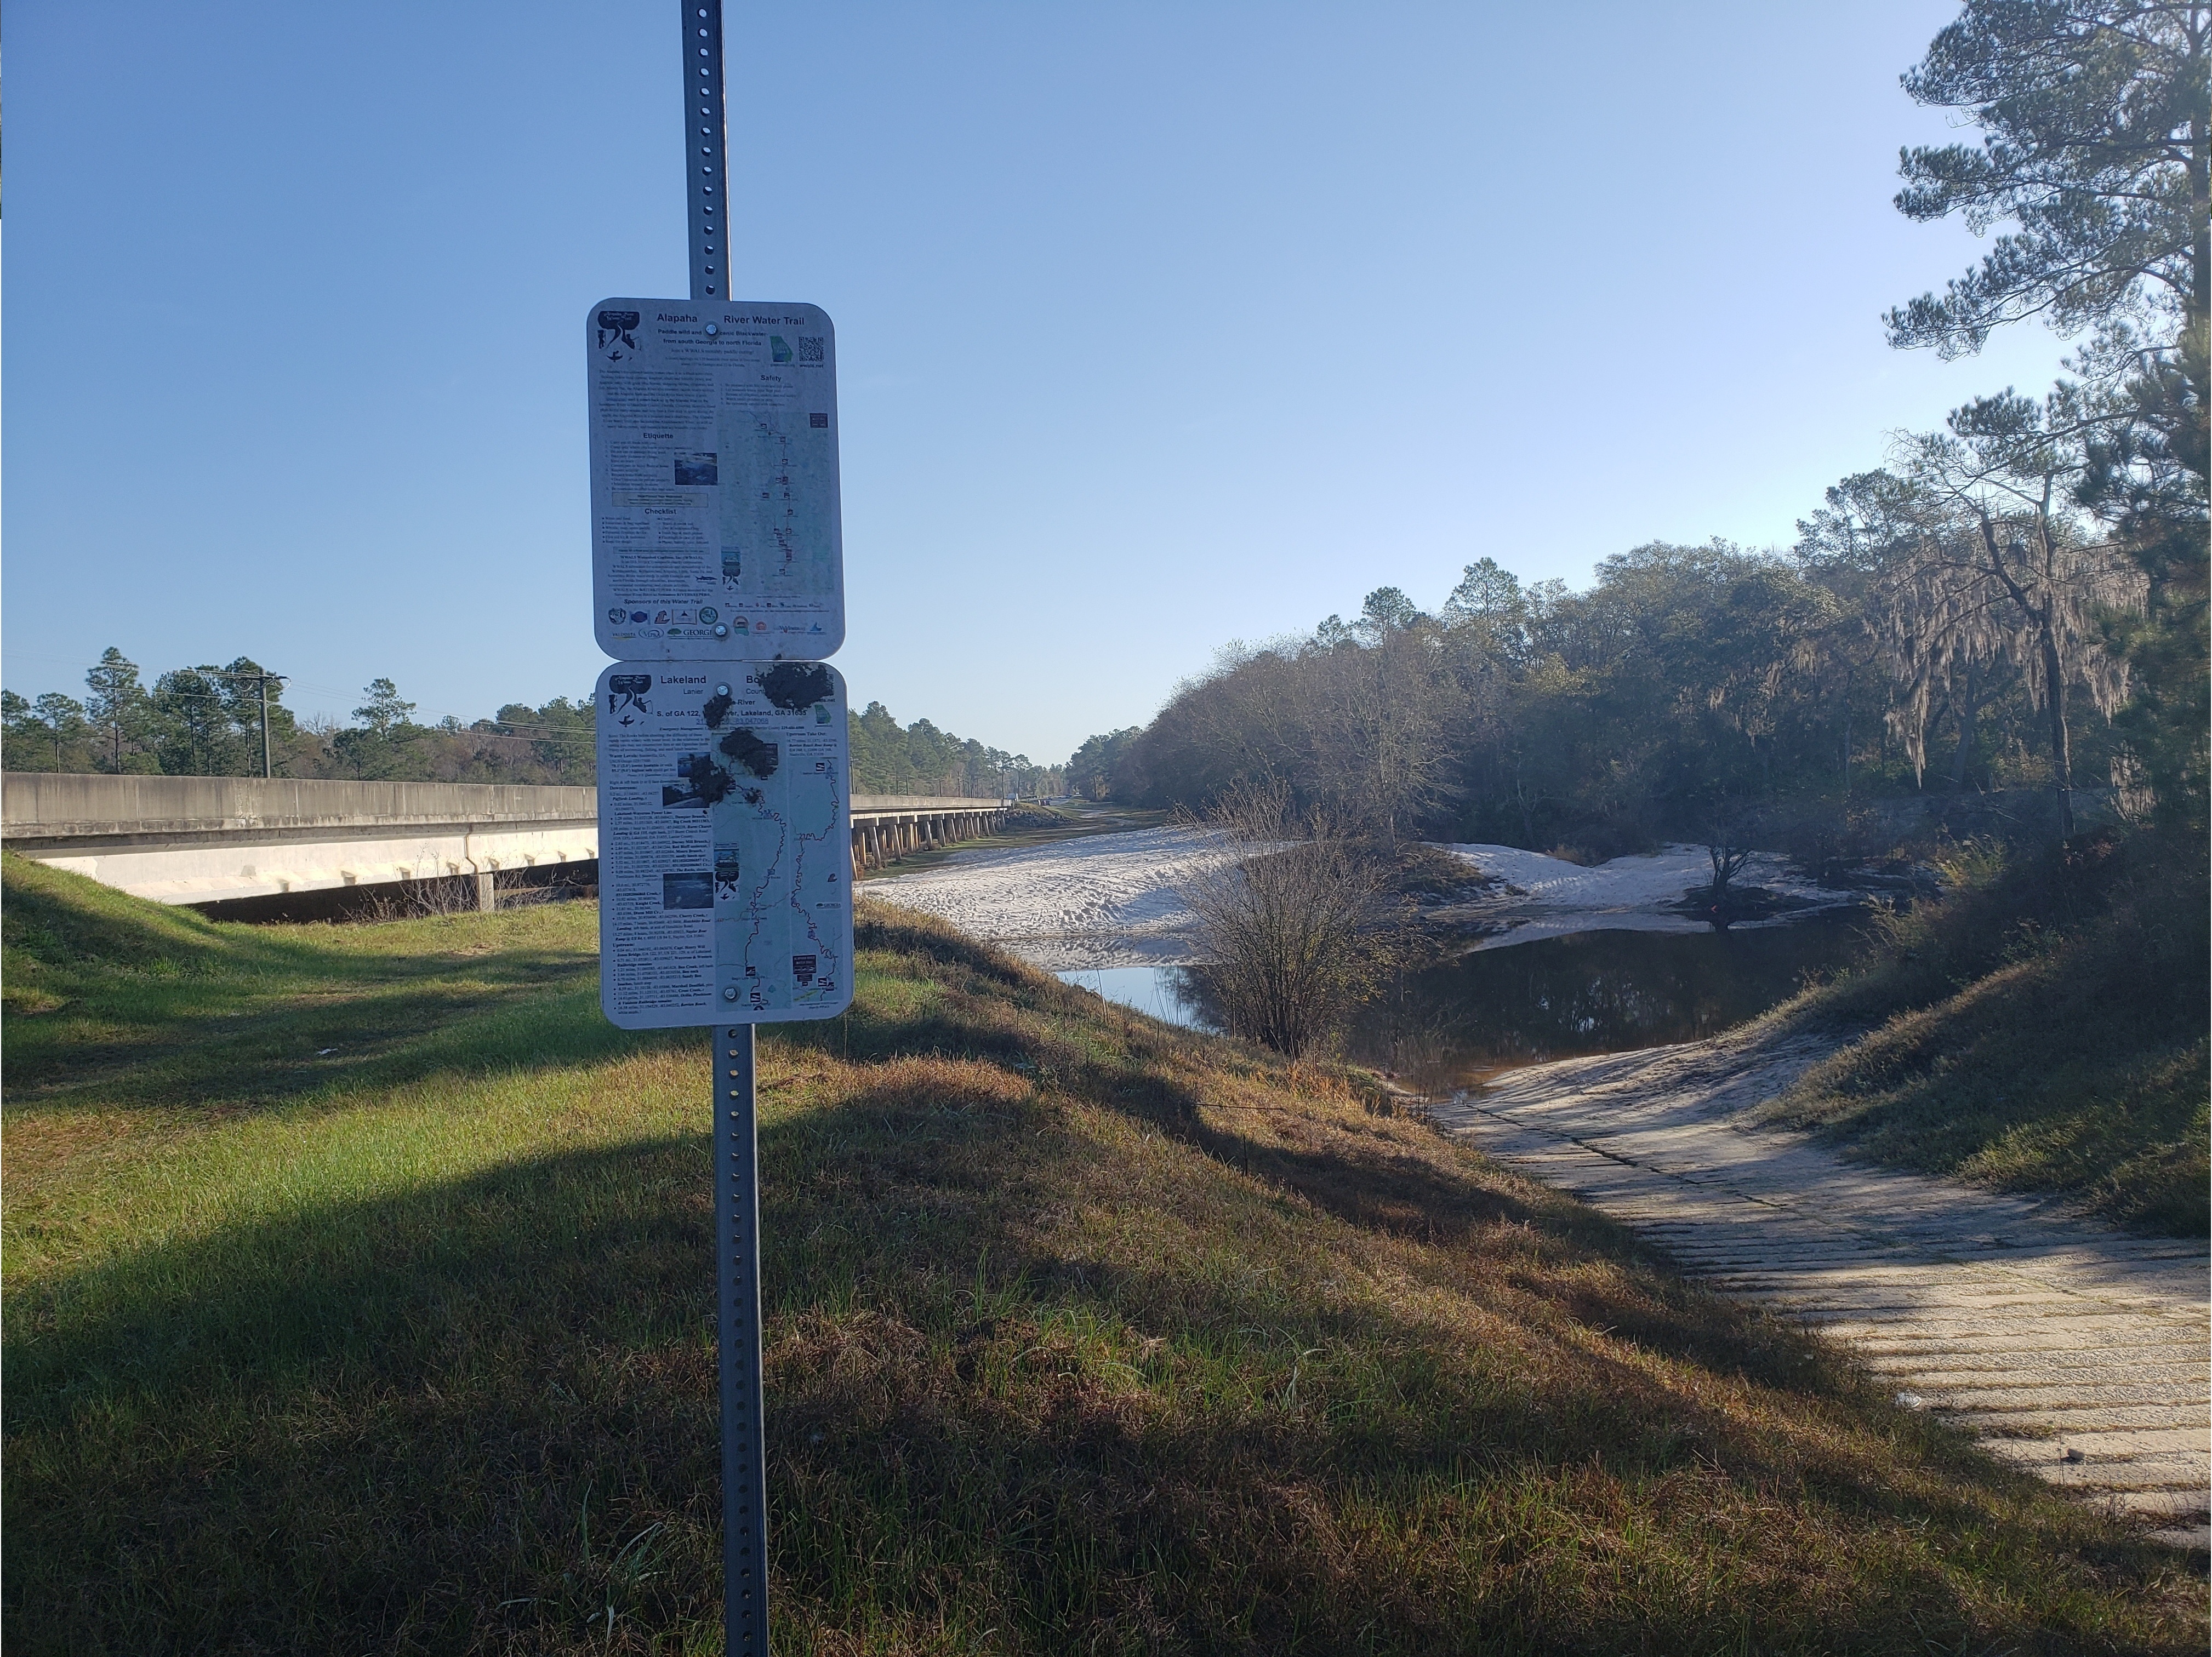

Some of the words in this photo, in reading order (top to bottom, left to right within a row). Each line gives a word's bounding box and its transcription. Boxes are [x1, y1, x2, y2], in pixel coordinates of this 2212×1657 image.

[657, 313, 698, 323] Alapaha
[724, 315, 750, 323] River
[752, 316, 781, 324] Water
[784, 317, 804, 325] Trail
[660, 676, 706, 684] Lakeland
